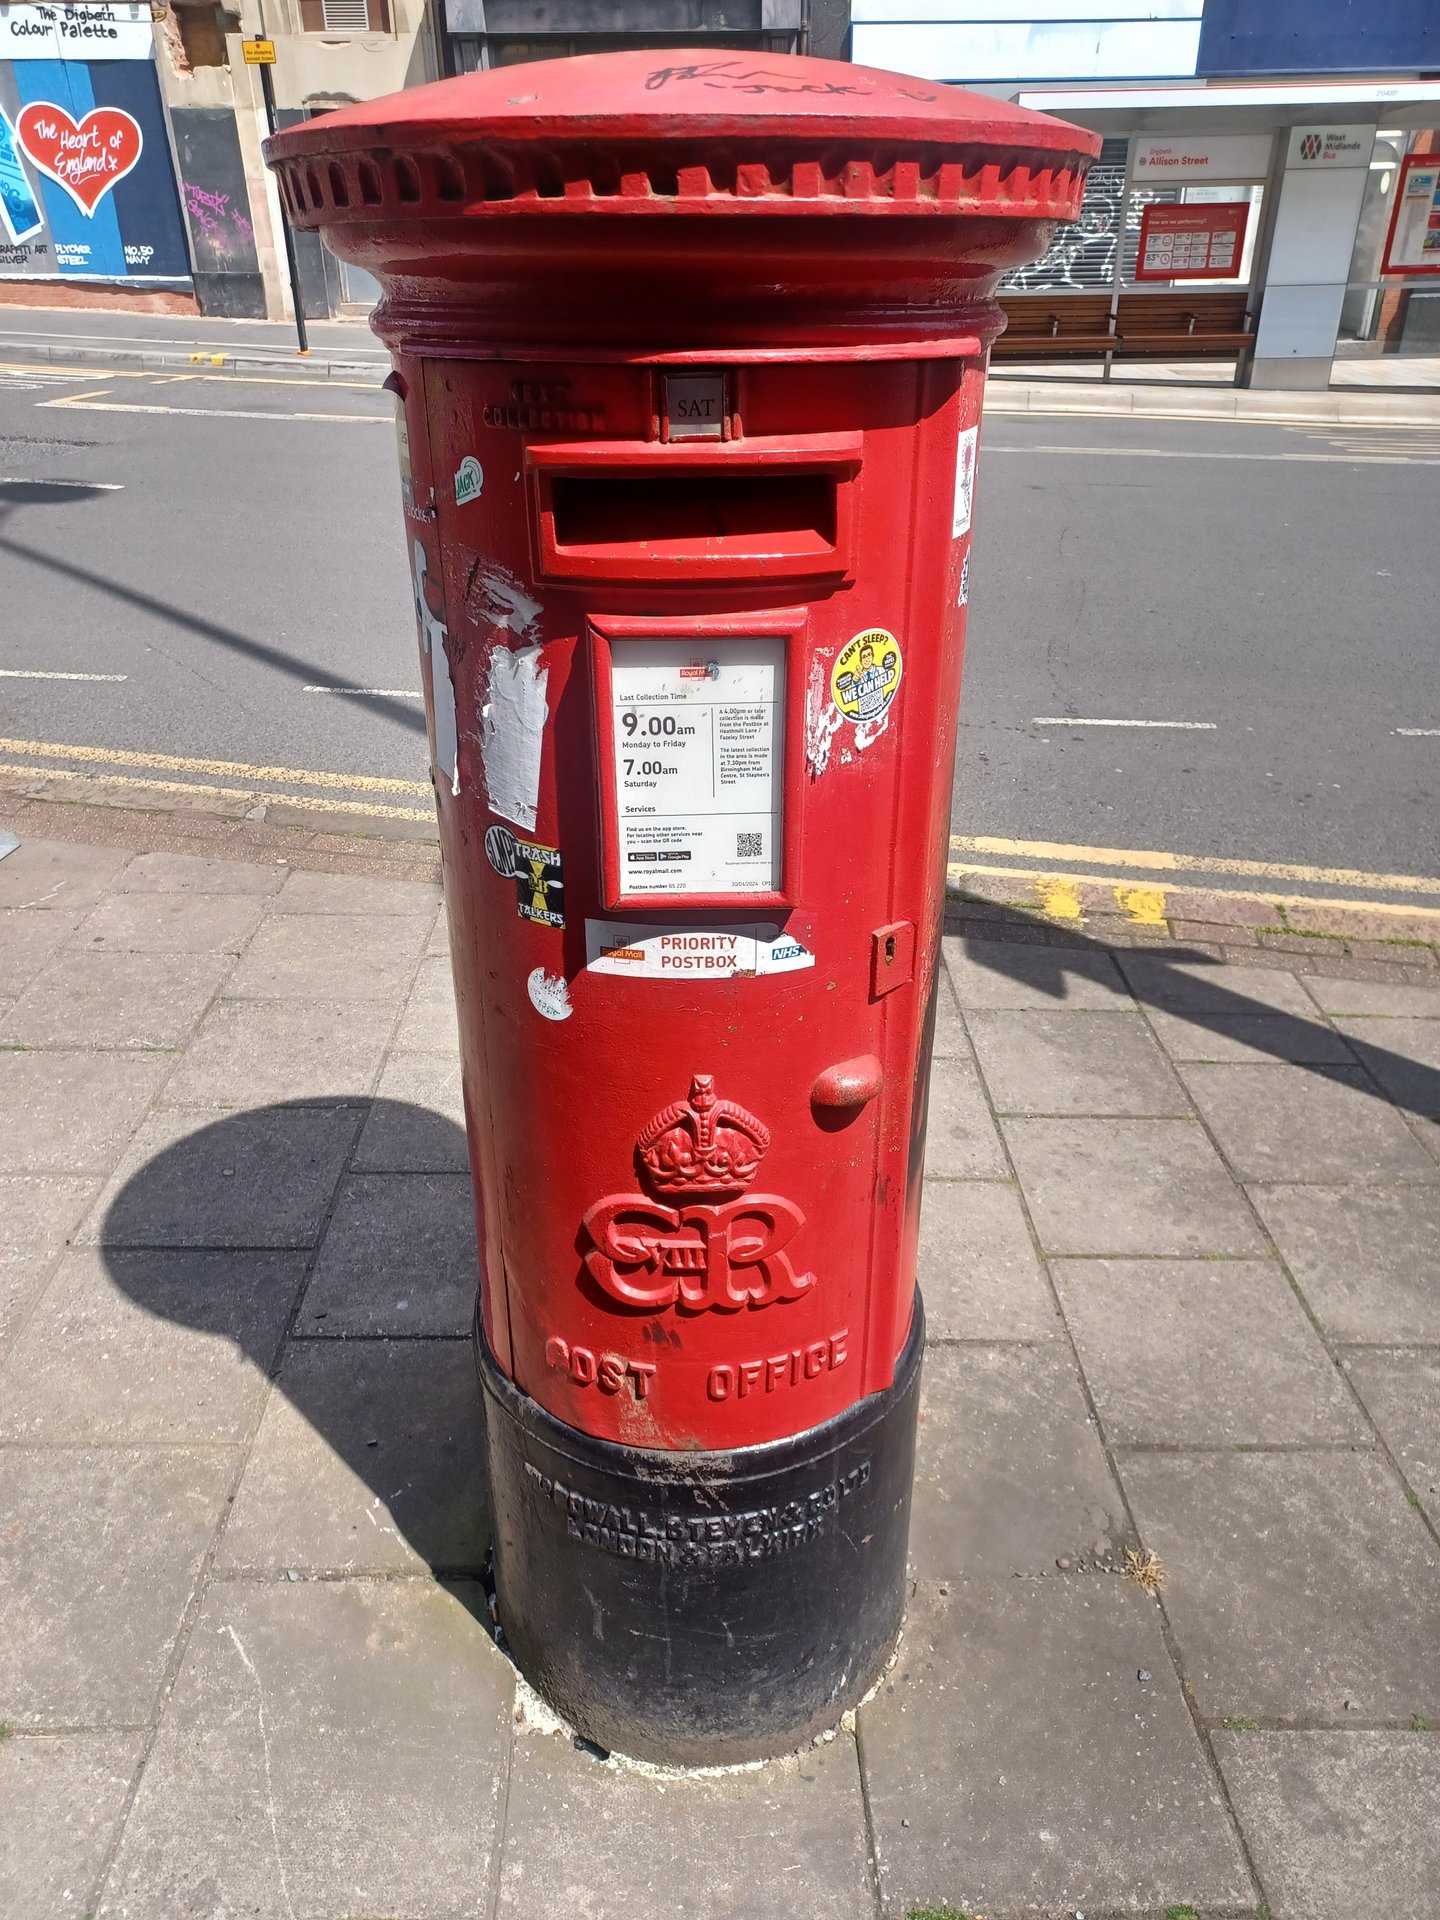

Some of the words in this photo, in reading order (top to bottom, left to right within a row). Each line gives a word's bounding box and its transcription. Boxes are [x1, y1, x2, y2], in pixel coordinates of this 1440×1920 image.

[36, 6, 57, 20] The
[64, 4, 115, 24] Digbeth
[11, 19, 53, 36] Colour
[59, 22, 118, 38] Palette
[33, 119, 58, 139] The
[60, 124, 101, 149] Heart
[109, 129, 123, 149] of
[1324, 141, 1361, 150] Midlands
[1149, 157, 1179, 166] Allison
[1181, 156, 1209, 165] Street
[34, 244, 48, 254] ART
[126, 255, 150, 265] NAVY
[678, 399, 715, 417] SAT
[840, 639, 861, 666] CAN'T
[862, 633, 889, 646] SLEEP?
[842, 687, 858, 704] WE
[857, 679, 875, 697] CAN
[874, 668, 896, 690] HELP
[670, 692, 687, 700] Time
[622, 712, 696, 737] 9.00am
[622, 741, 651, 749] Monday
[663, 740, 686, 748] Friday
[623, 759, 678, 776] 7.00am
[624, 780, 657, 788] Saturday
[625, 805, 656, 813] Services
[514, 842, 561, 867] TRASH
[518, 902, 564, 924] TALKERS
[661, 936, 737, 950] PRIORITY
[625, 950, 643, 958] Mail
[773, 946, 800, 960] NHS
[661, 955, 737, 969] POSTBOX
[708, 1328, 849, 1402] OFFICE
